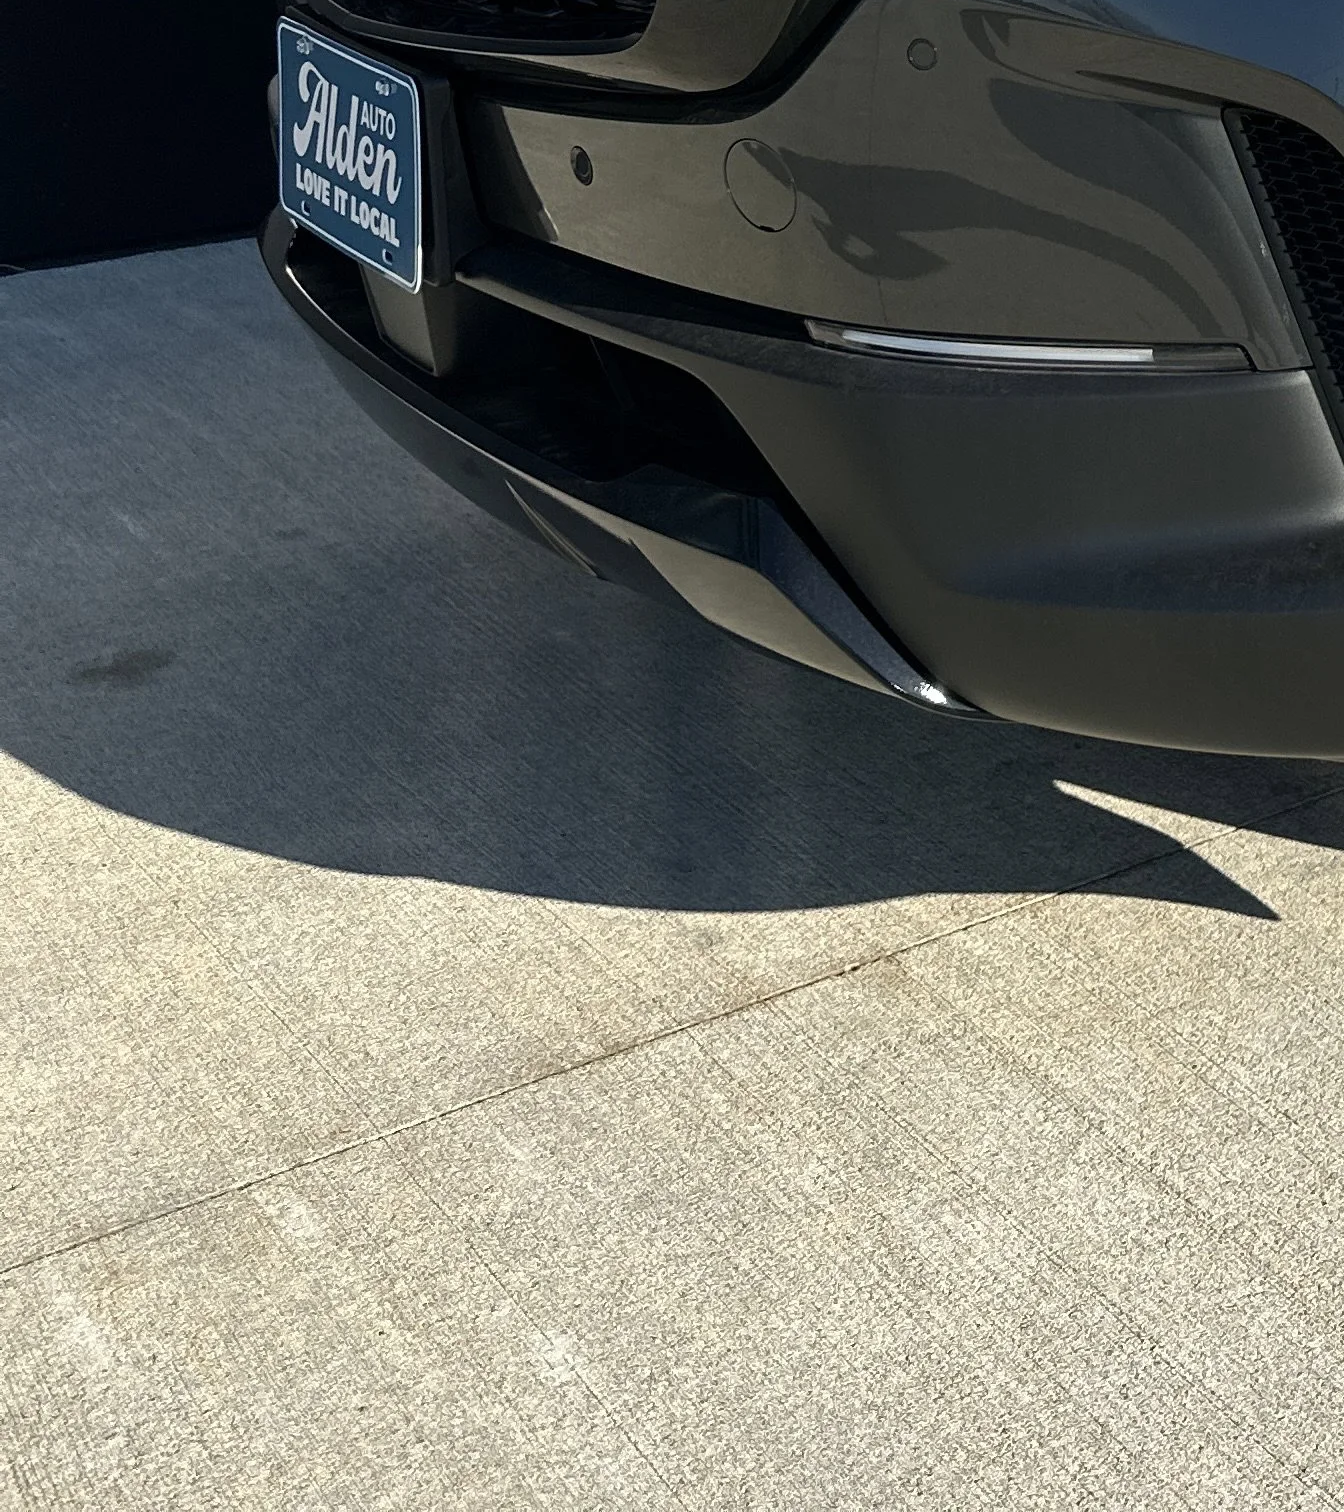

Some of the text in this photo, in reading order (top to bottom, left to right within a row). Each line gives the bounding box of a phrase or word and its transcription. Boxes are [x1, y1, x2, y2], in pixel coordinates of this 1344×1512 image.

[293, 61, 402, 205] Alden
[360, 101, 396, 140] AUTO
[296, 162, 400, 248] LOVE IT LOCAL
